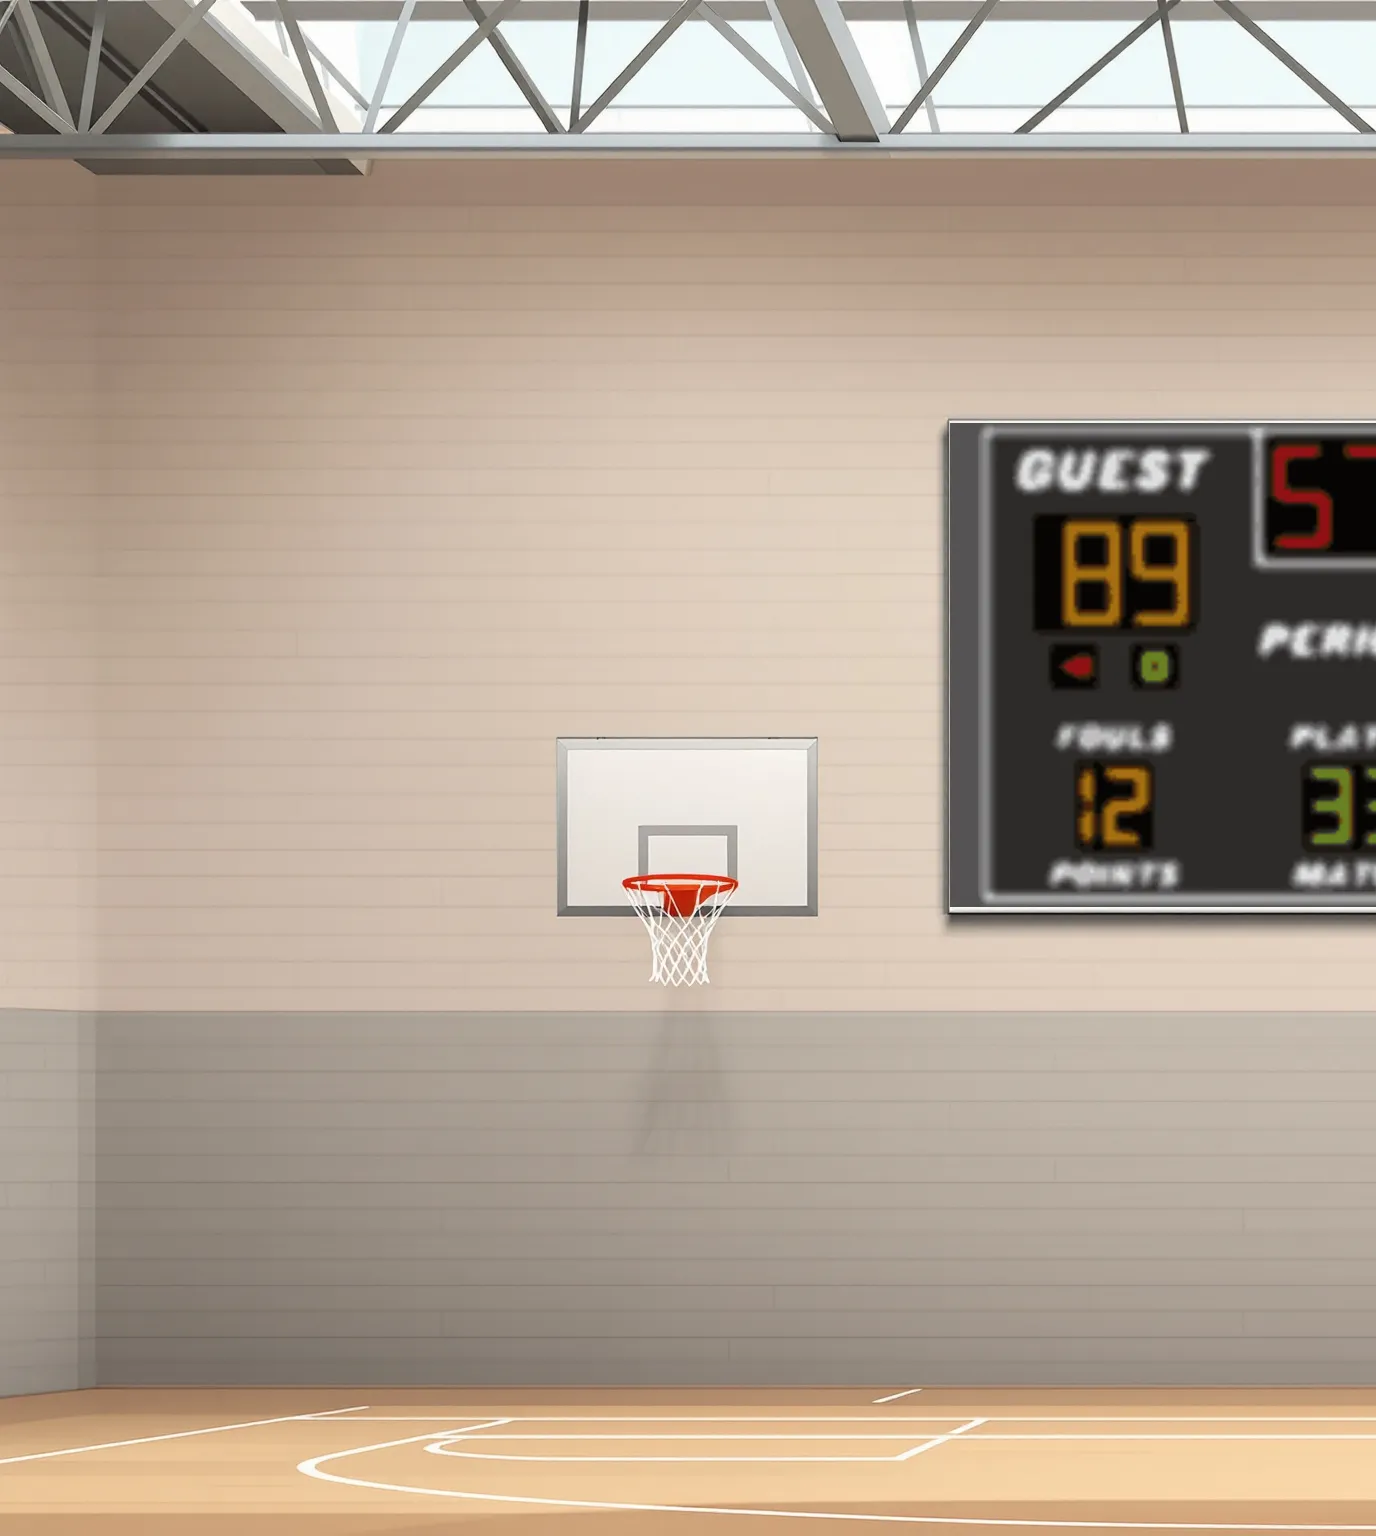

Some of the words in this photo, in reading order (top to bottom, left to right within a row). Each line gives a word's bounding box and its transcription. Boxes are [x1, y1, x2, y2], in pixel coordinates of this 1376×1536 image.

[1014, 447, 1212, 493] GUEST
[1062, 520, 1190, 626] 89
[1056, 722, 1173, 753] FOULS
[1078, 766, 1150, 845] 12
[1048, 860, 1180, 890] POINTS
